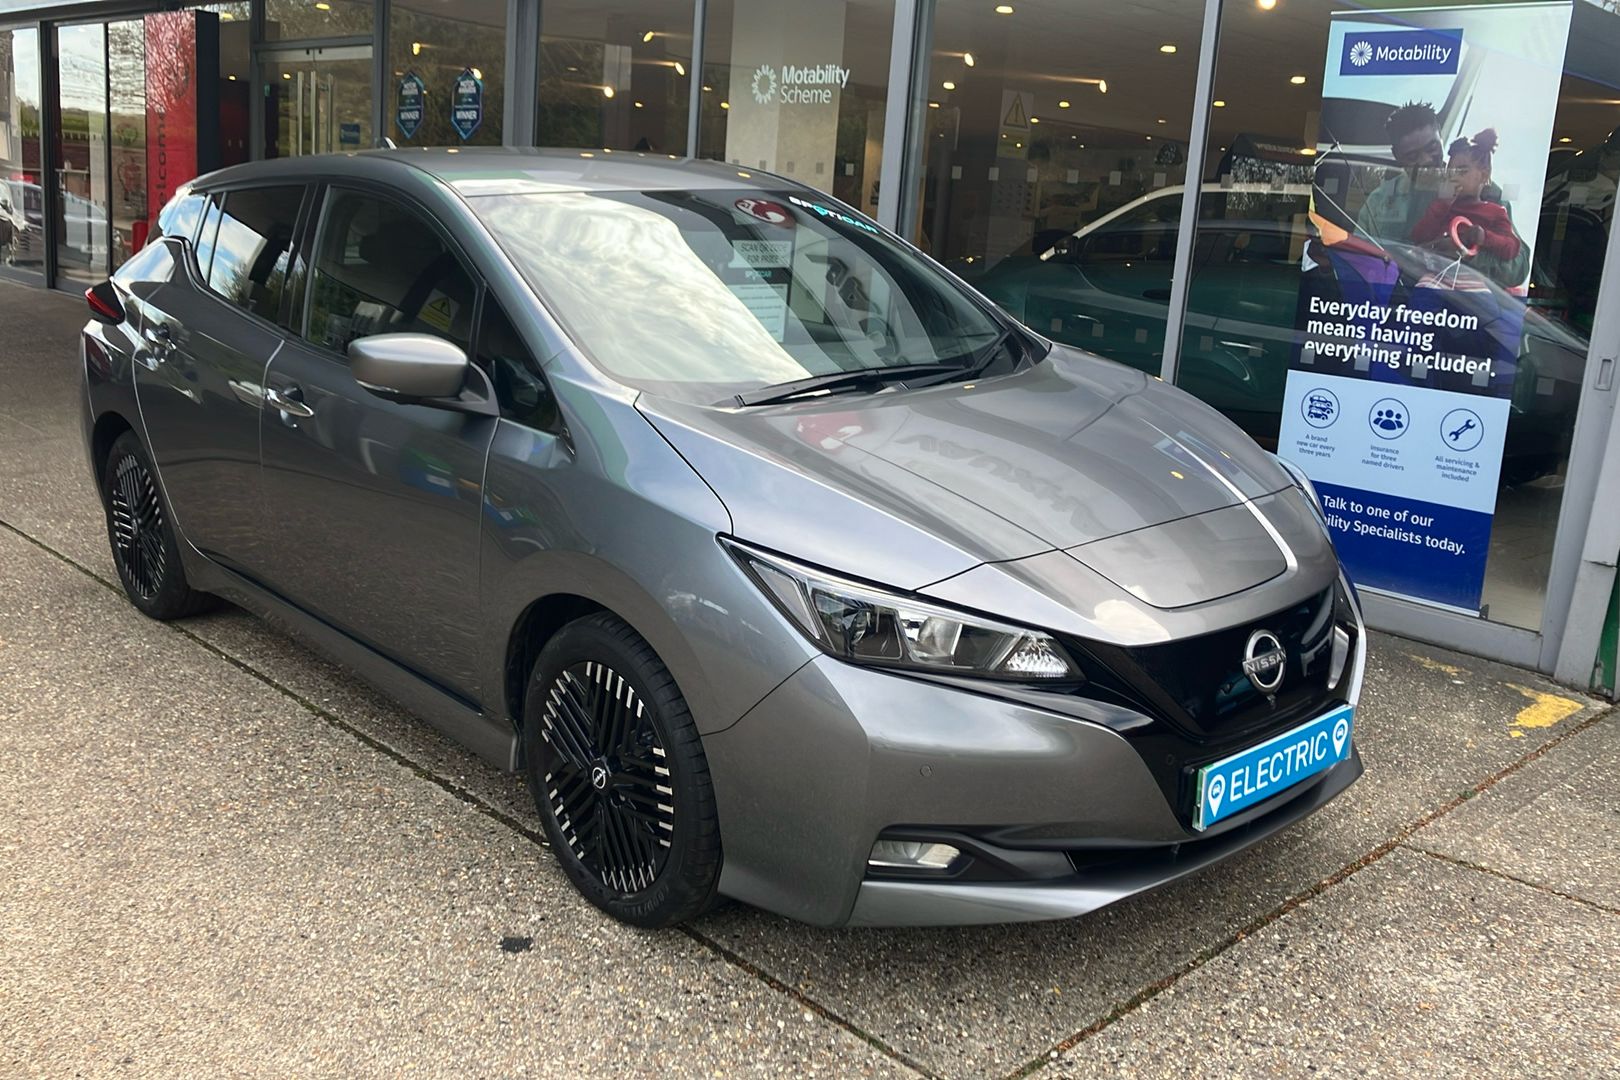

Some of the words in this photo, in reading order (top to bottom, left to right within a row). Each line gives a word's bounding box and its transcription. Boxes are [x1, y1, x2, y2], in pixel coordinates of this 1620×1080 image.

[1376, 44, 1452, 64] Motability
[782, 64, 850, 89] Motability
[780, 85, 832, 104] Scheme
[400, 111, 420, 120] WINNER
[455, 110, 478, 120] WINNER
[788, 196, 879, 234] SPOTICAR
[1309, 297, 1391, 324] Everyday
[1396, 304, 1478, 330] freedom
[1307, 320, 1366, 339] means
[1371, 323, 1434, 351] having
[1304, 341, 1401, 369] everything
[1406, 348, 1496, 377] included.
[1311, 434, 1328, 443] brand
[1319, 443, 1335, 452] every
[1299, 447, 1314, 455] three
[1315, 450, 1331, 458] years
[1380, 453, 1397, 462] three
[1362, 459, 1382, 468] named
[1383, 461, 1404, 471] drivers
[1436, 464, 1477, 475] maintenance
[1445, 457, 1474, 469] servicing
[1441, 471, 1470, 482] included
[1323, 495, 1347, 511] Talk
[1350, 501, 1363, 514] to
[1366, 505, 1390, 519] one
[1393, 510, 1409, 522] of
[1410, 514, 1434, 527] our
[1353, 520, 1422, 544] Specialists
[1425, 535, 1466, 555] today.
[1246, 650, 1287, 675] NISSAN
[1230, 731, 1328, 802] ELECTRIC
